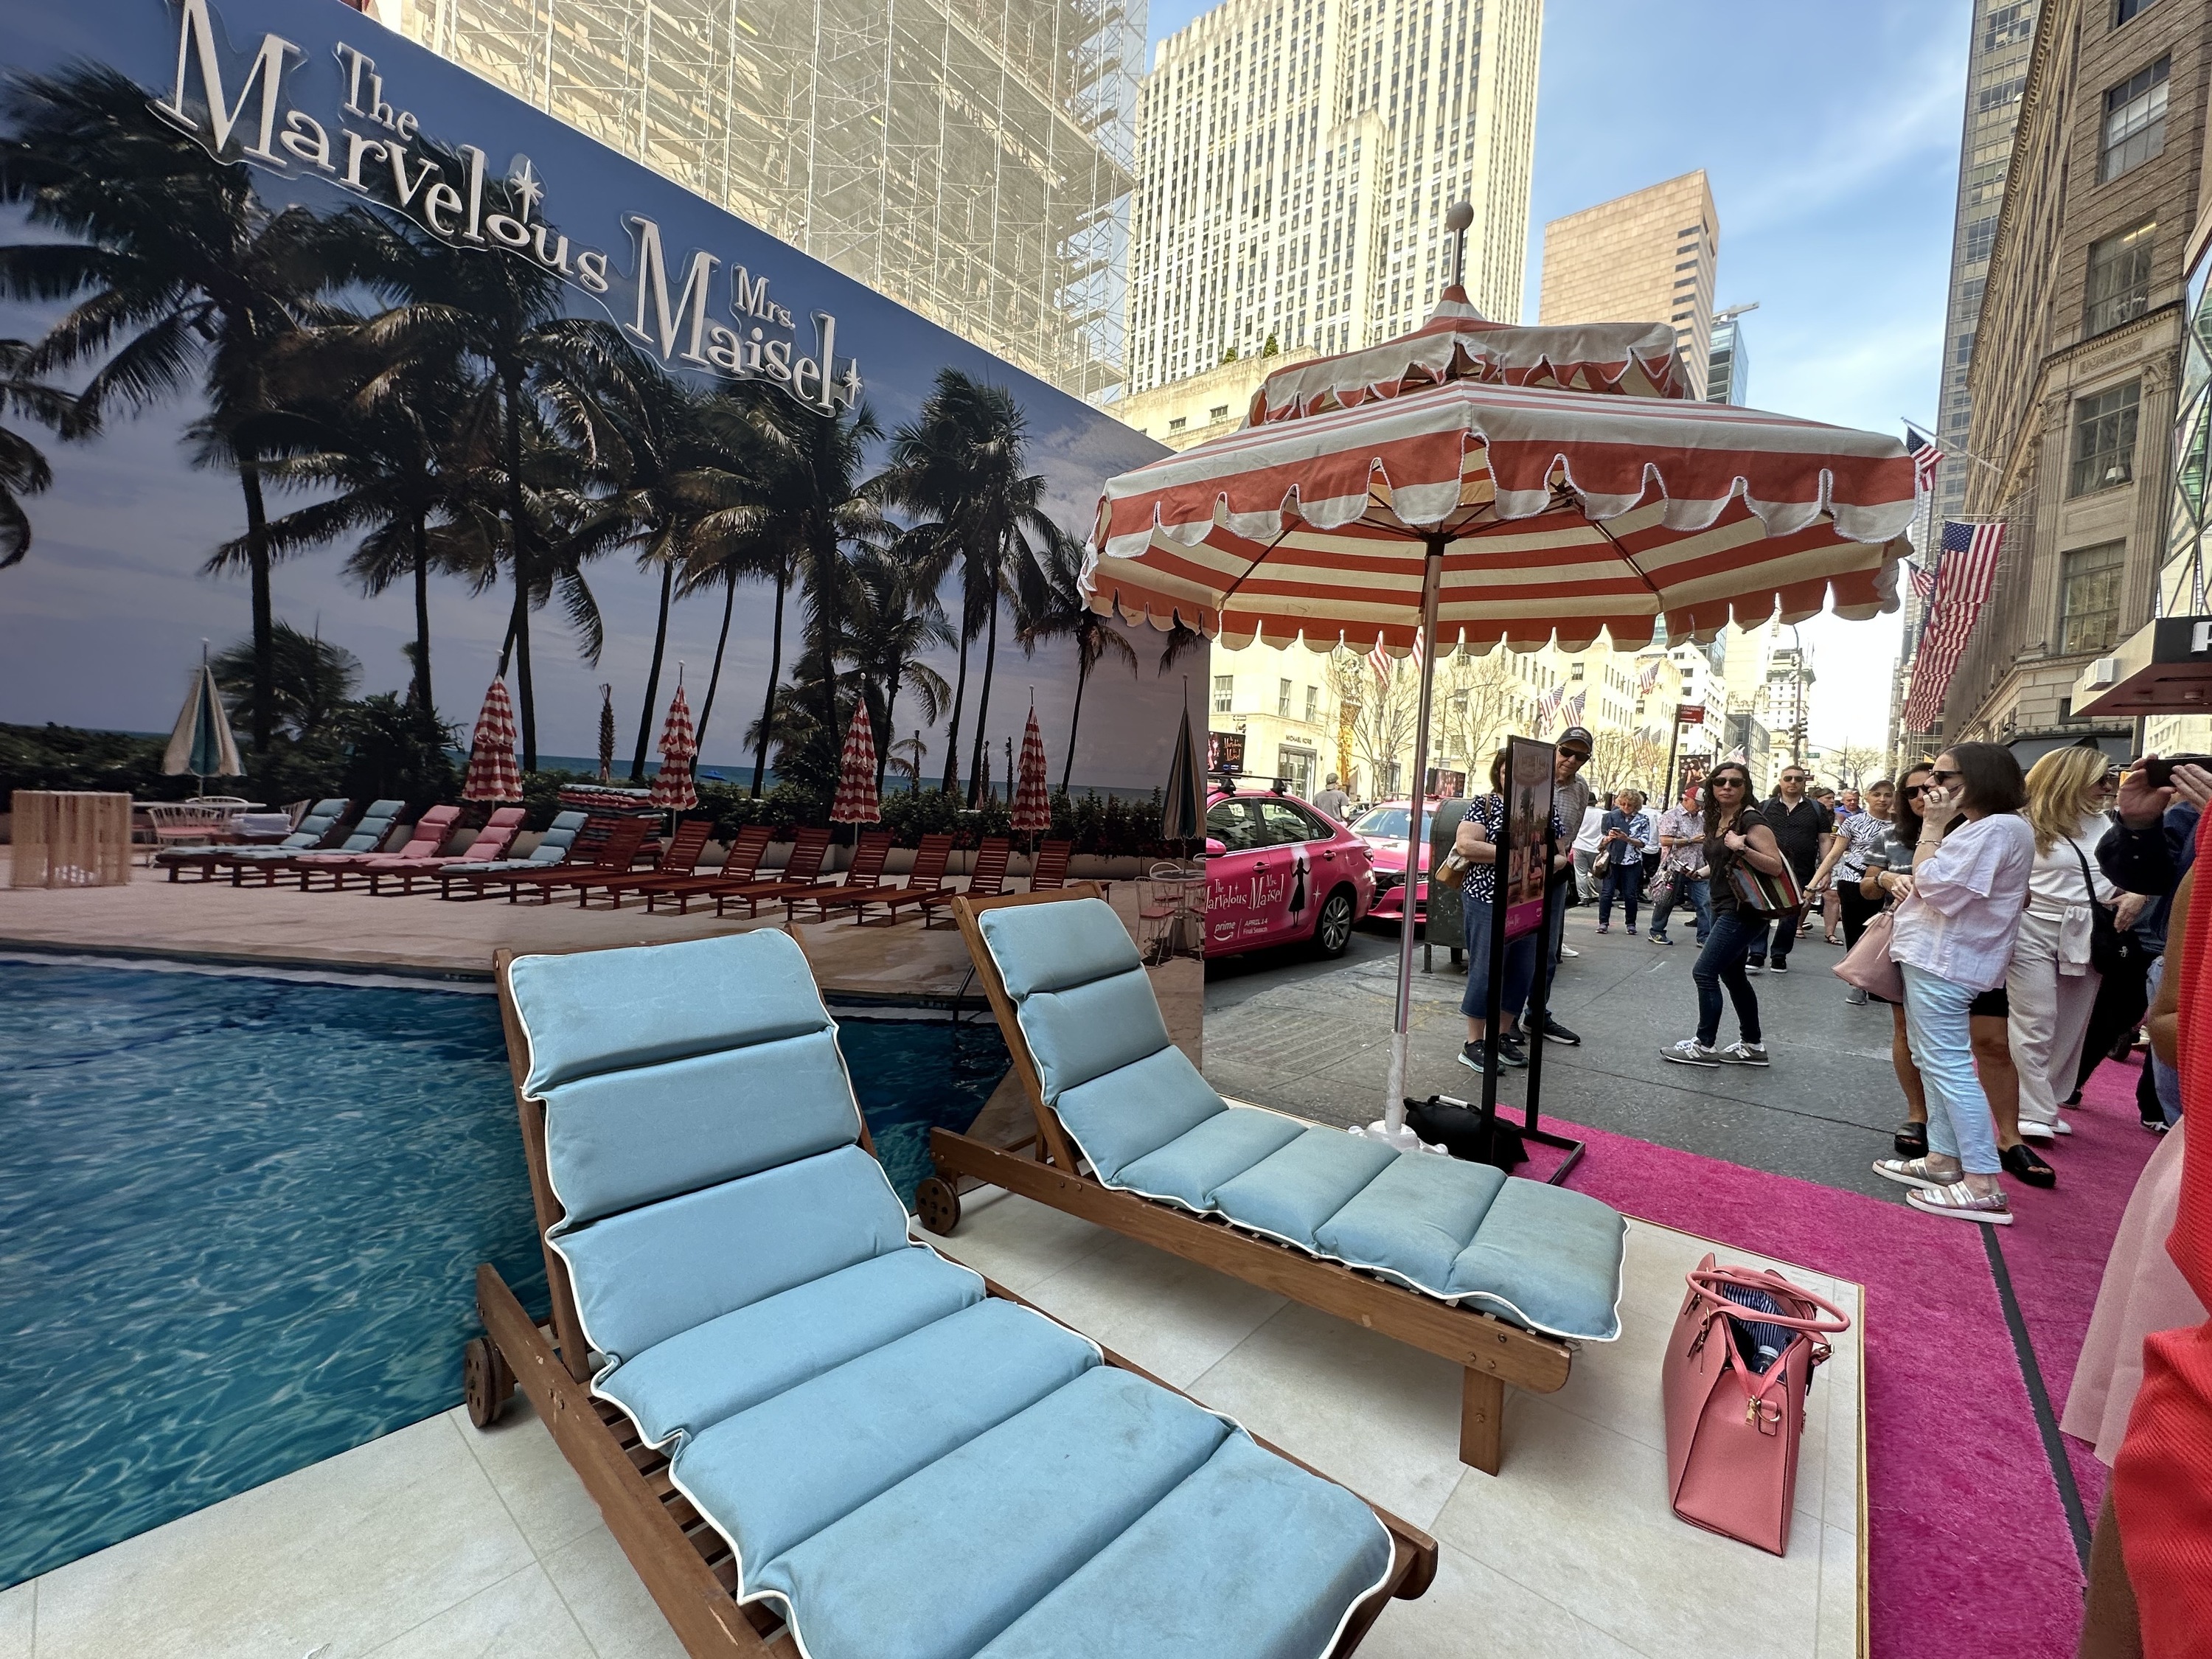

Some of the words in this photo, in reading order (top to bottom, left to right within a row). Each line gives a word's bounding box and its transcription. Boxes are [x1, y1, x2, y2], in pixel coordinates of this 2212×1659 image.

[338, 41, 420, 141] The
[155, 0, 608, 293] Marvelous
[624, 216, 835, 410] Maisel
[1215, 879, 1224, 893] The
[1248, 874, 1284, 911] Maisel
[1214, 921, 1236, 934] prime
